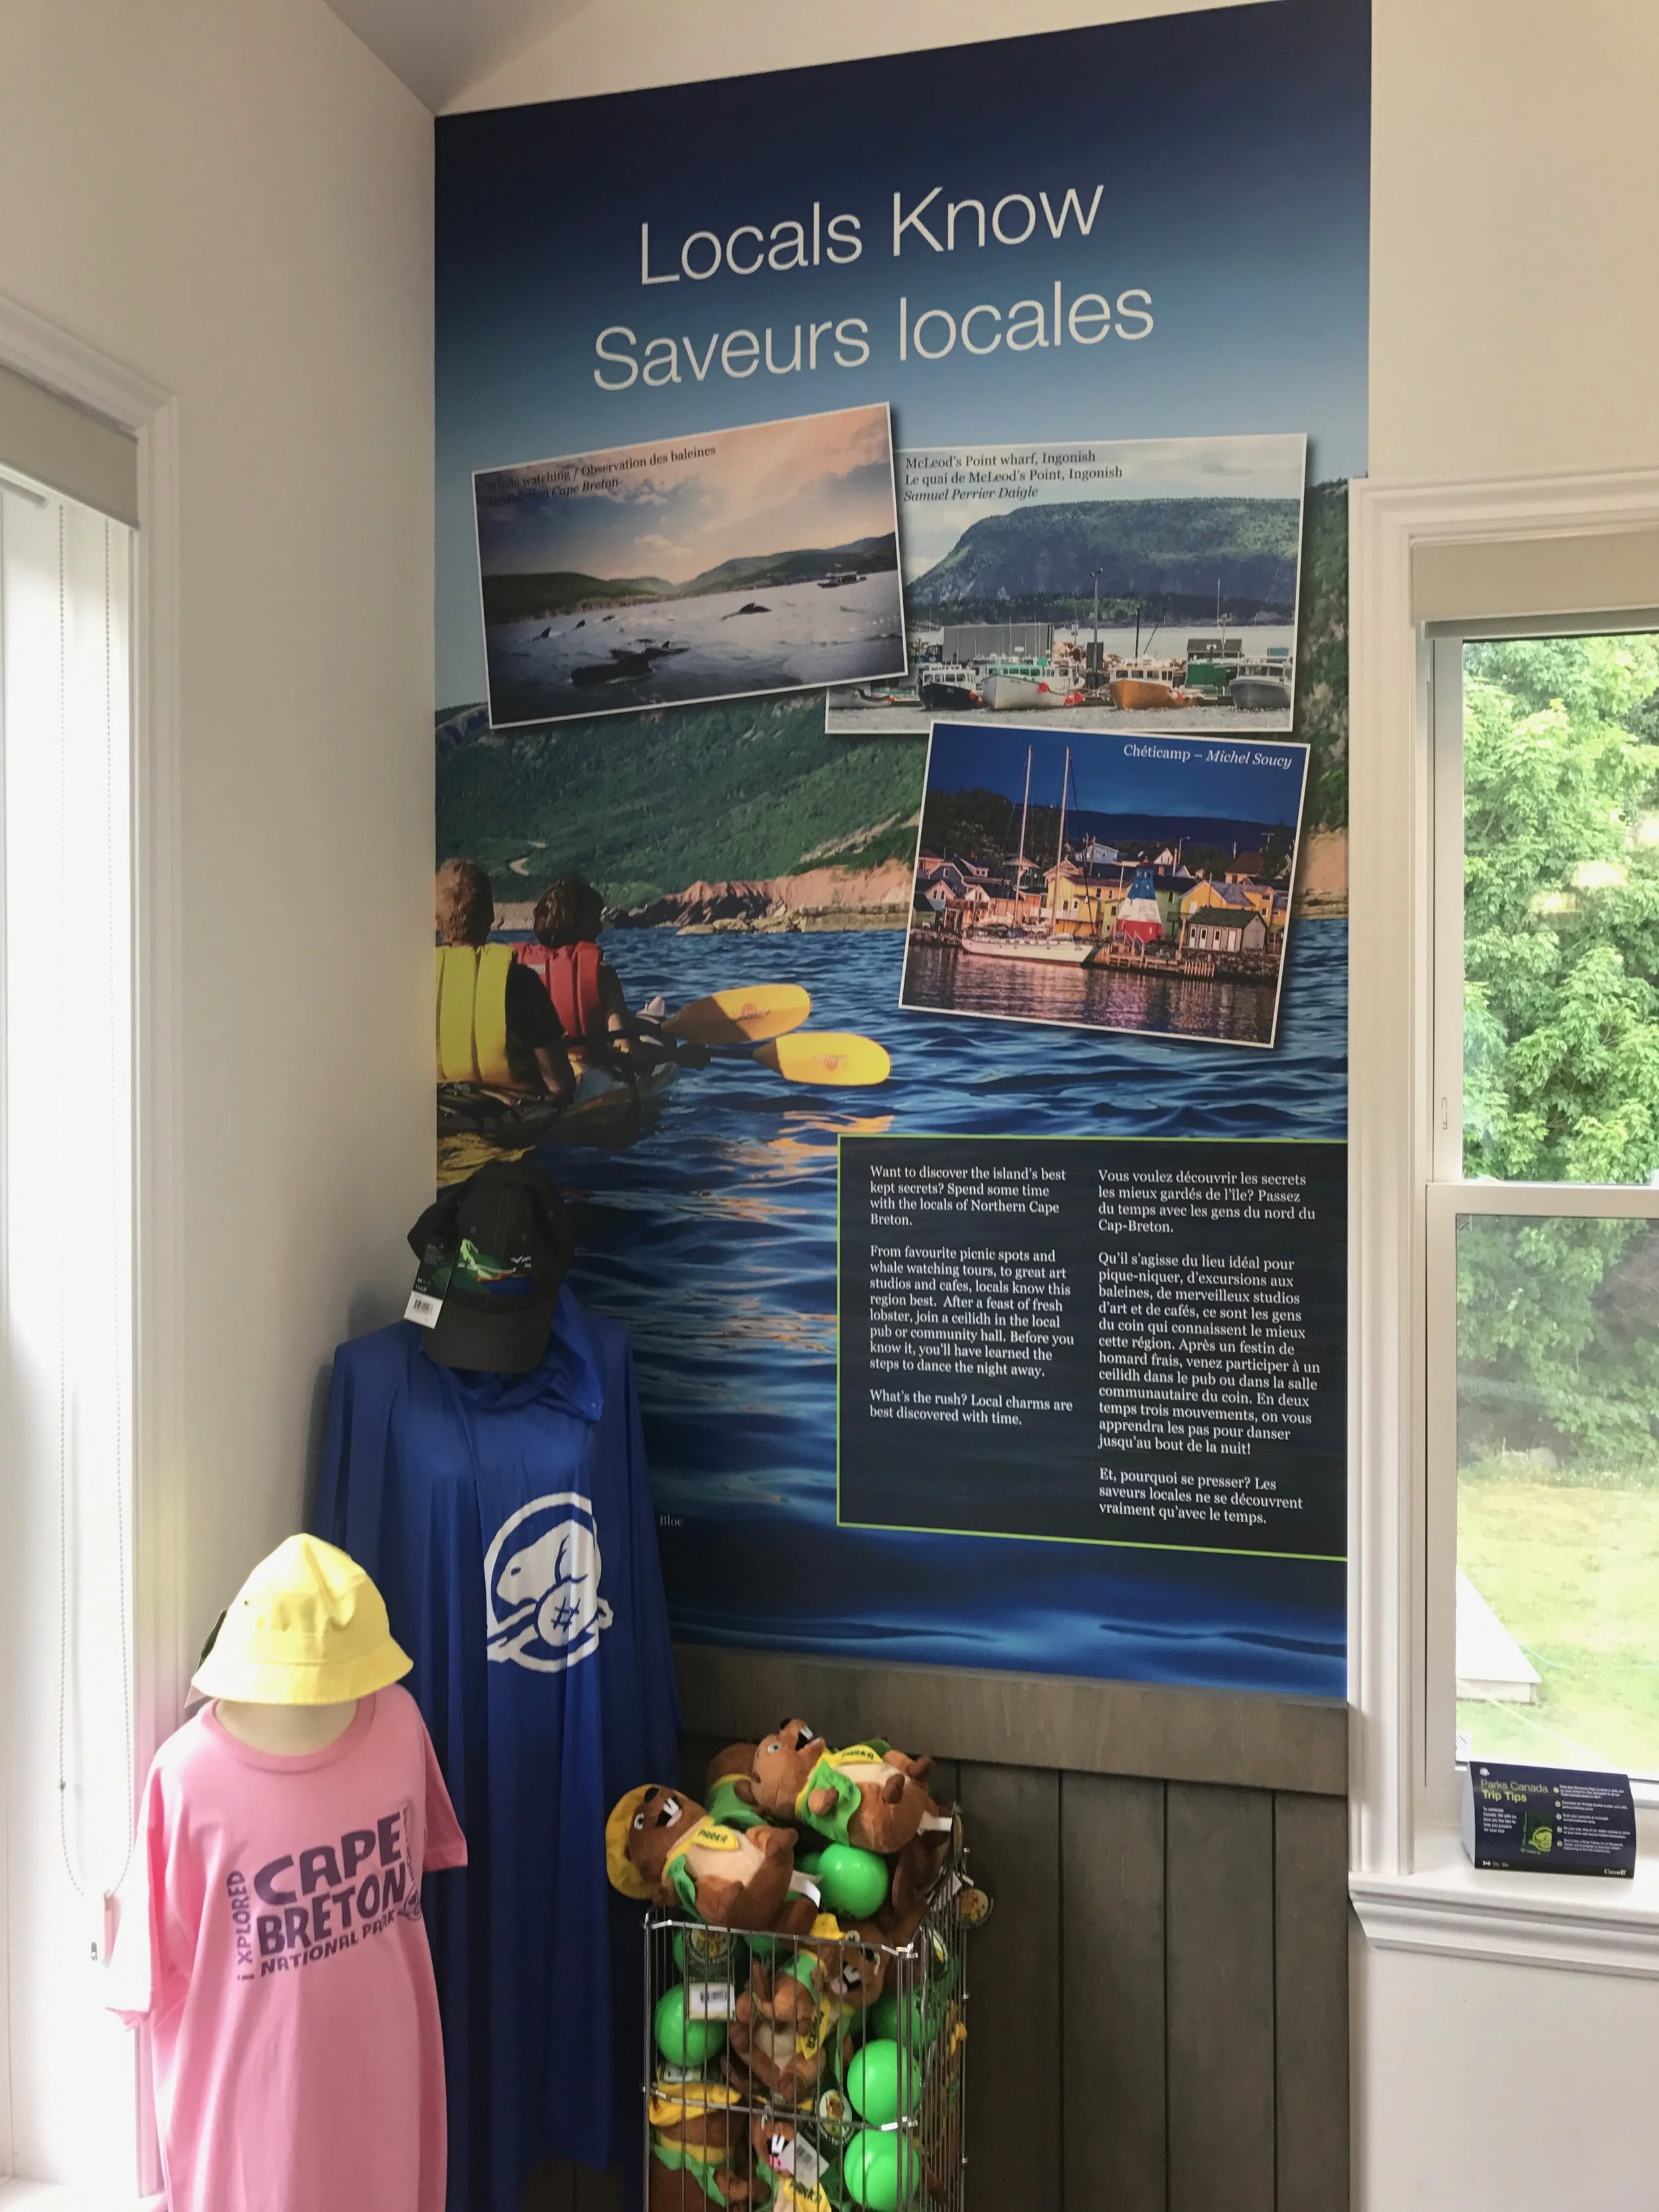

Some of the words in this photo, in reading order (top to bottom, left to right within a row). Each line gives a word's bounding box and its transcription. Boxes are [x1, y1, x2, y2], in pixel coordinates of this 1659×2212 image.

[641, 201, 863, 285] Locals
[893, 184, 1105, 257] Know
[593, 316, 871, 392] Saveurs
[899, 280, 1155, 362] locales
[522, 470, 571, 488] watching
[581, 458, 646, 477] Observation
[649, 453, 669, 465] des
[670, 445, 717, 463] baleines
[906, 454, 962, 469] McLeod's
[965, 454, 997, 467] Point
[1000, 453, 1039, 467] wharf,
[1042, 450, 1096, 467] Ingonish
[904, 475, 919, 486] Le
[922, 473, 948, 488] quai
[950, 471, 966, 484] de
[968, 468, 1026, 485] McLeod's
[1029, 469, 1066, 483] Point,
[1068, 466, 1123, 483] Ingonish
[551, 484, 579, 498] Cape
[582, 479, 620, 492] Breton
[903, 488, 949, 502] Samuel
[952, 488, 995, 501] Perrier
[998, 486, 1039, 502] Daigle
[1123, 743, 1190, 763] Chéticamp
[1205, 750, 1250, 765] Michel
[1252, 752, 1293, 770] Soucy
[869, 1165, 902, 1179] Want
[904, 1166, 917, 1179] to
[918, 1165, 969, 1179] discover
[970, 1165, 990, 1180] the
[993, 1166, 1038, 1181] island's
[1041, 1167, 1066, 1181] best
[1098, 1169, 1129, 1183] Vous
[1132, 1169, 1173, 1183] voulez
[1175, 1169, 1238, 1185] découvrir
[1240, 1171, 1258, 1185] les
[1261, 1173, 1307, 1186] secrets
[869, 1180, 896, 1197] kept
[897, 1182, 945, 1195] secrets?
[946, 1181, 985, 1199] Spend
[986, 1185, 1019, 1197] some
[1022, 1183, 1050, 1197] time
[1098, 1184, 1116, 1199] les
[1118, 1185, 1157, 1199] mieux
[1160, 1186, 1202, 1203] gardés
[1205, 1187, 1221, 1201] de
[1224, 1187, 1254, 1202] l'île?
[1258, 1189, 1301, 1203] Passez
[869, 1196, 896, 1211] with
[899, 1196, 917, 1211] the
[920, 1197, 953, 1211] locals
[956, 1197, 969, 1212] of
[970, 1198, 1027, 1213] Northern
[1029, 1200, 1060, 1217] Cape
[1098, 1201, 1115, 1215] du
[1118, 1203, 1156, 1218] temps
[1159, 1206, 1188, 1217] avec
[1190, 1203, 1208, 1217] les
[1210, 1207, 1241, 1220] gens
[1244, 1205, 1261, 1219] du
[1263, 1206, 1295, 1220] nord
[1298, 1206, 1315, 1220] du
[870, 1212, 913, 1226] Breton.
[1098, 1218, 1174, 1234] Cap-Breton.
[870, 1244, 902, 1258] From
[904, 1244, 957, 1260] favourite
[960, 1246, 996, 1263] picnic
[998, 1249, 1030, 1264] spots
[1033, 1248, 1056, 1263] and
[1098, 1251, 1128, 1267] Qu'il
[1131, 1252, 1179, 1269] s'agisse
[1181, 1253, 1198, 1268] du
[1201, 1253, 1226, 1268] lieu
[1229, 1255, 1260, 1270] idéal
[1263, 1260, 1295, 1273] pour
[869, 1259, 904, 1274] whale
[906, 1260, 960, 1279] watching
[962, 1264, 997, 1279] tours,
[999, 1265, 1013, 1278] to
[1014, 1266, 1046, 1281] great
[1048, 1267, 1067, 1280] art
[1098, 1267, 1184, 1286] pique-niquer,
[1187, 1270, 1267, 1287] d'excursions
[1270, 1277, 1294, 1288] aux
[869, 1276, 912, 1291] studios
[914, 1277, 937, 1291] and
[938, 1278, 973, 1295] cafes,
[974, 1278, 1009, 1294] locals
[1011, 1280, 1046, 1295] know
[1047, 1282, 1071, 1296] this
[1098, 1283, 1153, 1301] baleines,
[1156, 1286, 1172, 1300] de
[1175, 1288, 1250, 1303] merveilleux
[1253, 1290, 1301, 1305] studios
[869, 1291, 906, 1308] region
[909, 1292, 937, 1307] best.
[942, 1294, 974, 1309] After
[975, 1298, 983, 1309] a
[986, 1295, 1015, 1311] feast
[1017, 1297, 1031, 1311] of
[1033, 1297, 1063, 1312] fresh
[869, 1388, 910, 1404] What's
[912, 1390, 932, 1404] the
[934, 1392, 968, 1406] rush?
[970, 1393, 1003, 1408] Local
[1005, 1394, 1051, 1411] charms
[1052, 1400, 1074, 1412] are
[869, 1404, 894, 1419] best
[896, 1405, 960, 1422] discovered
[961, 1409, 989, 1424] with
[991, 1410, 1023, 1426] time.
[1097, 1433, 1152, 1451] jusqu'au
[1155, 1436, 1184, 1451] bout
[1187, 1438, 1202, 1453] de
[1205, 1439, 1218, 1453] la
[1220, 1441, 1251, 1455] nuit!
[1099, 1467, 1118, 1483] Et,
[1119, 1471, 1178, 1487] pourquoi
[1180, 1475, 1194, 1486] se
[1197, 1476, 1252, 1490] presser?
[1254, 1476, 1277, 1491] Les
[1099, 1486, 1147, 1499] saveurs
[1149, 1485, 1192, 1503] locales
[1194, 1493, 1212, 1504] ne
[1213, 1494, 1228, 1505] se
[1230, 1491, 1303, 1510] découvrent
[1098, 1501, 1156, 1517] vraiment
[1158, 1504, 1206, 1520] qu'avec
[1209, 1507, 1221, 1522] le
[1224, 1509, 1267, 1526] temps.
[1480, 1779, 1509, 1790] Parks
[1510, 1781, 1549, 1793] Canada
[1481, 1791, 1502, 1801] Trip
[1504, 1792, 1528, 1803] Tips
[253, 1810, 403, 1906] CAPE
[226, 1870, 253, 1966] XPLORED
[256, 1862, 406, 1956] BRETON
[260, 1931, 360, 1978] NATIONAL
[362, 1909, 397, 1940] PARK
